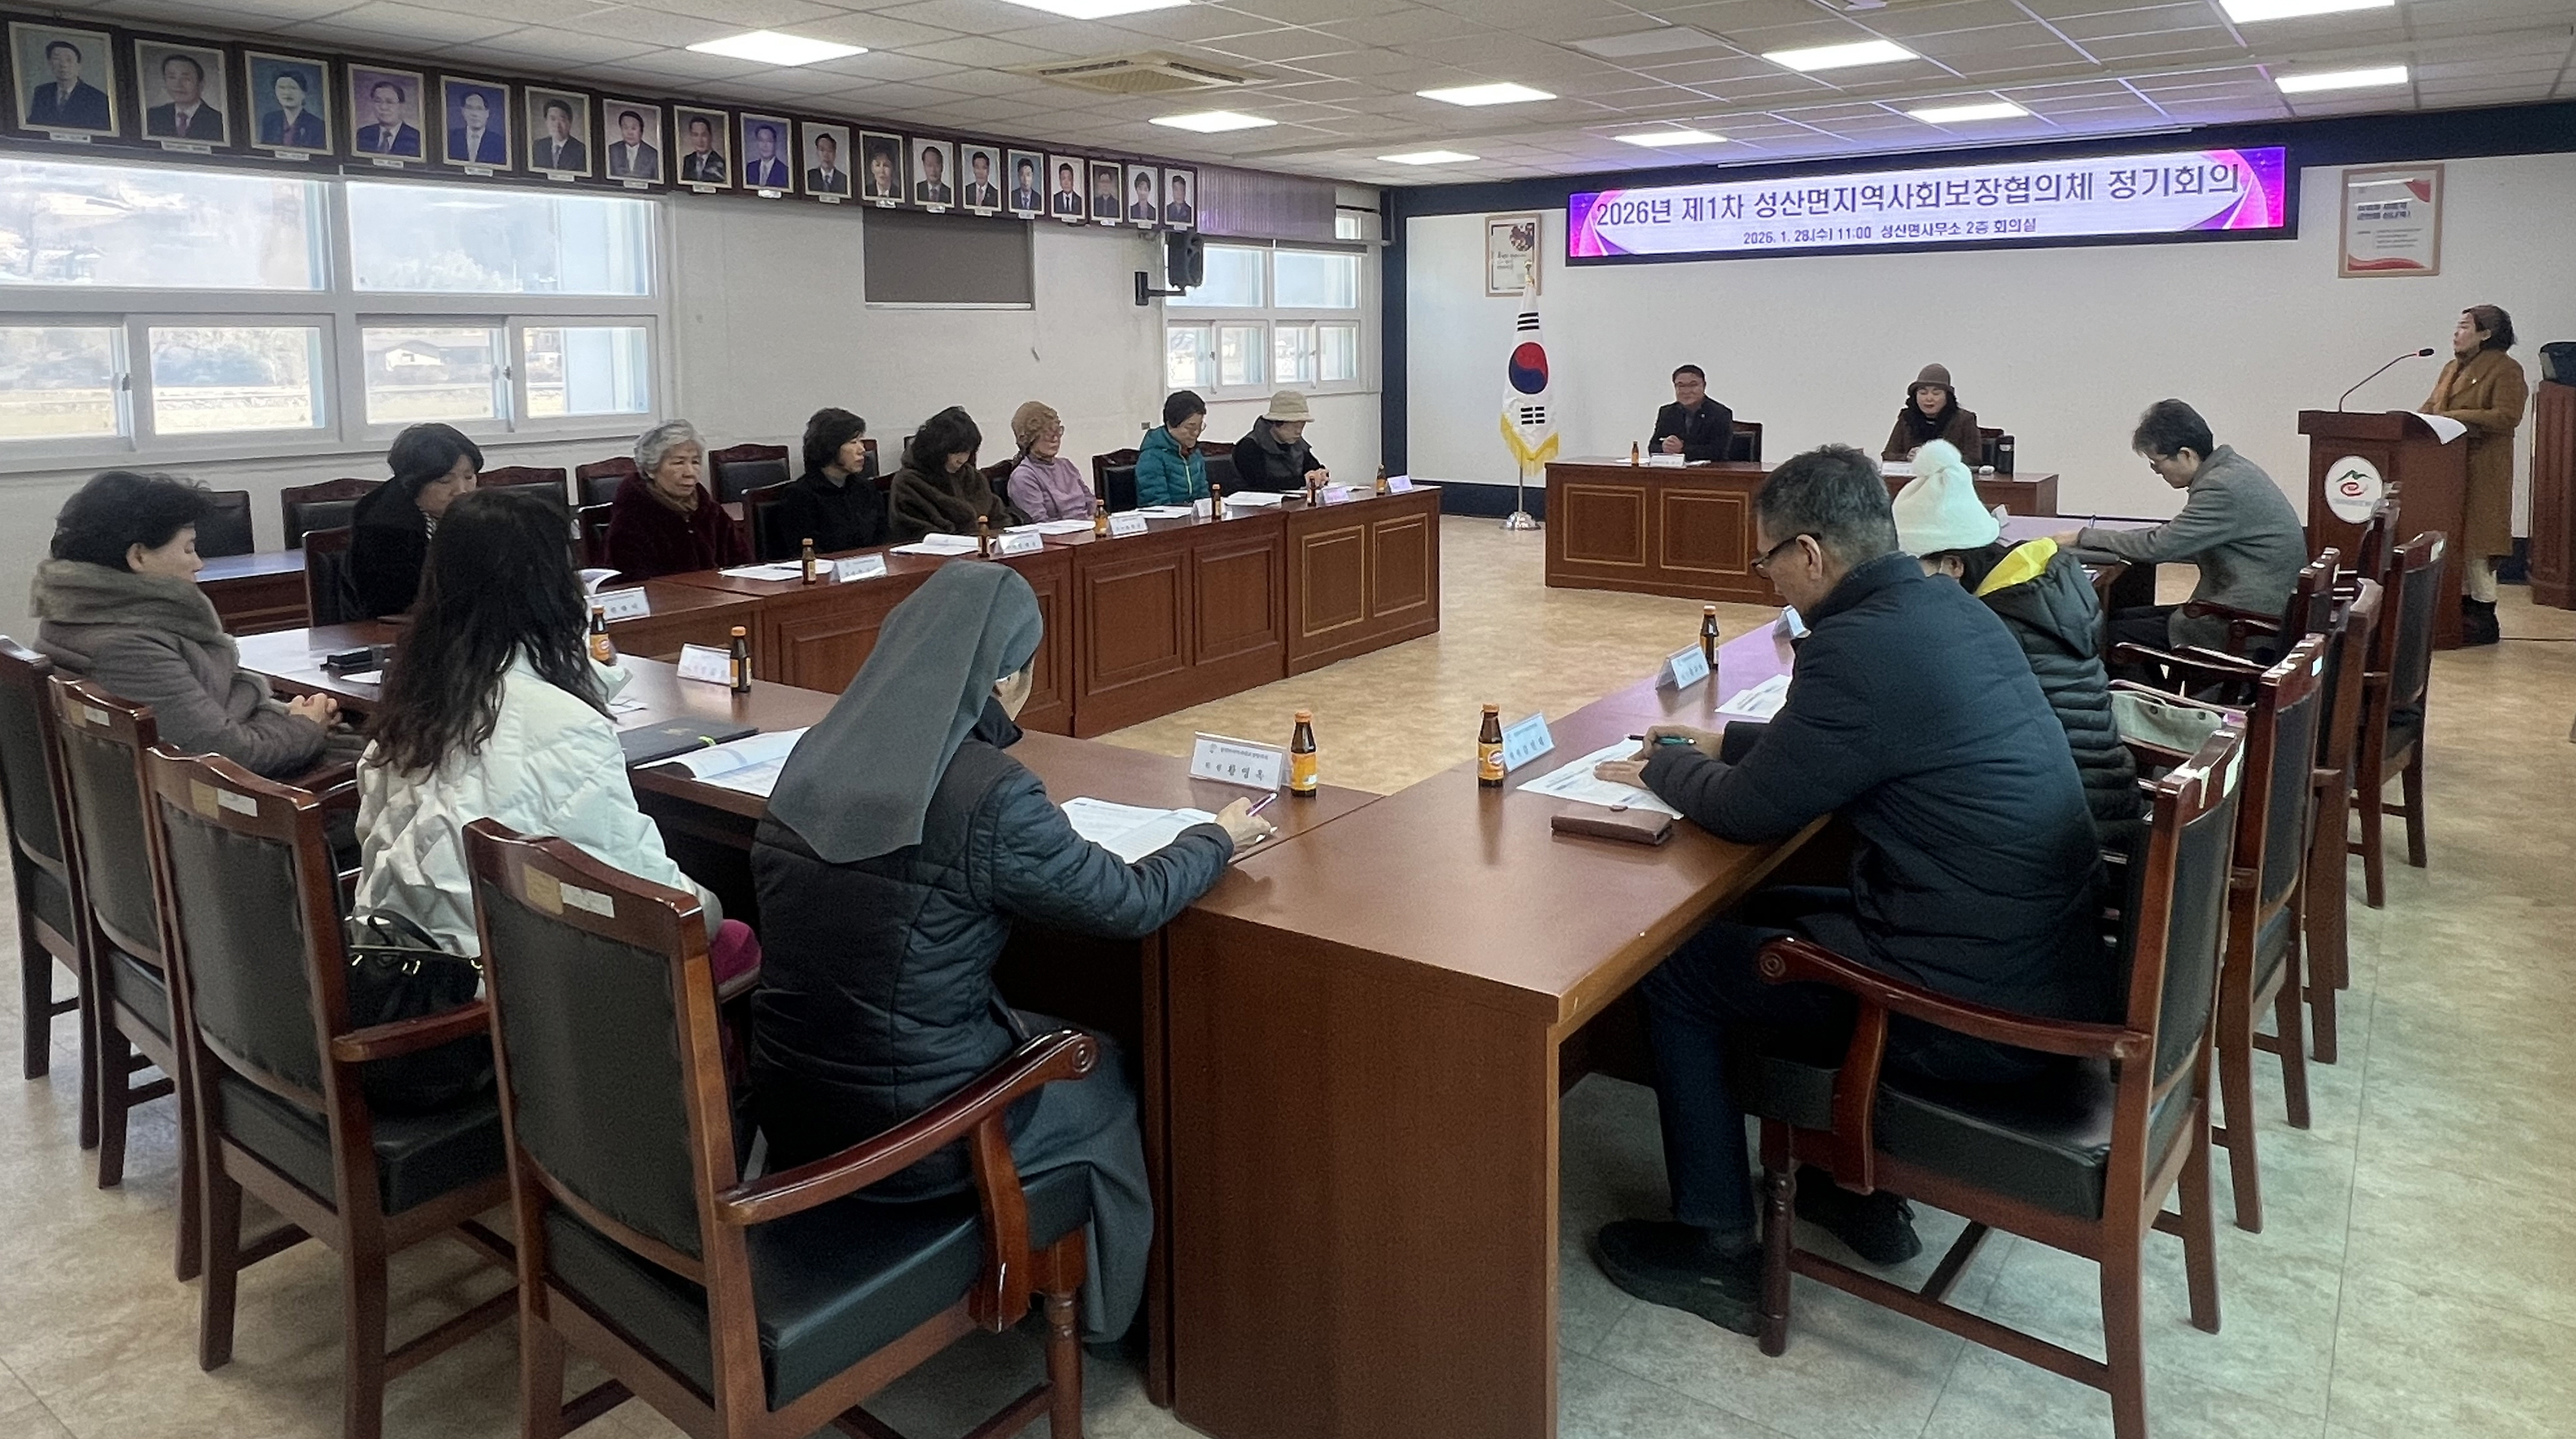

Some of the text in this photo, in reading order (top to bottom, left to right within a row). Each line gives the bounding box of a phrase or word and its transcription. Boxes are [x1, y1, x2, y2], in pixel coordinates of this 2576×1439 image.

[1597, 164, 2239, 226] 2026년 제1차 성산면지역사회보장협의체 정기회의
[1744, 231, 1776, 245] 2026.
[1781, 231, 1790, 242] 1.
[1839, 226, 1872, 240] 11:00
[1993, 218, 2037, 233] 회의실
